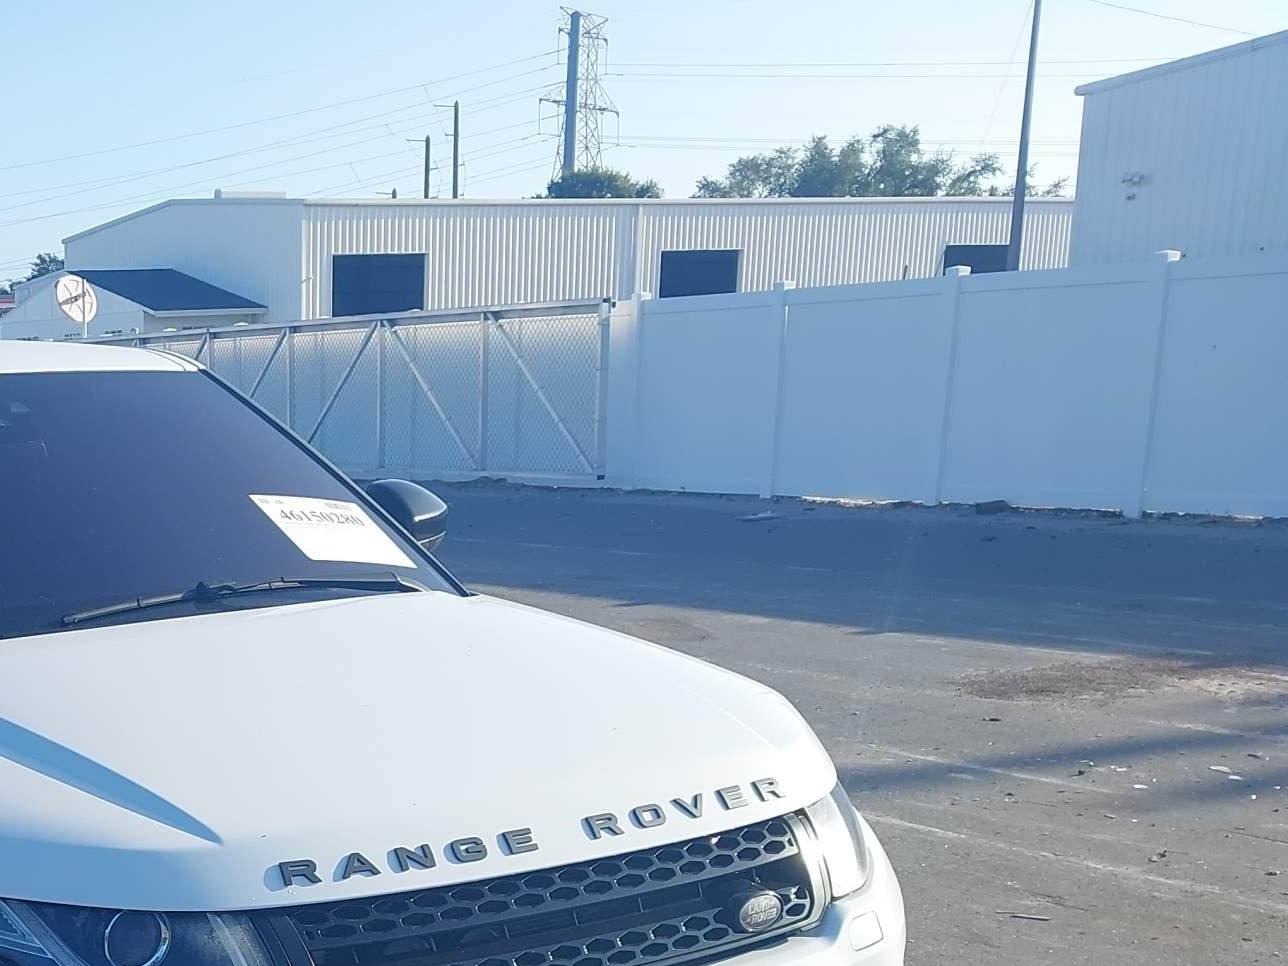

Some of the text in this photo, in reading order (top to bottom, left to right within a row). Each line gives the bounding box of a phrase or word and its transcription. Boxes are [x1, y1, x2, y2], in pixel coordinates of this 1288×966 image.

[279, 508, 367, 528] 46150280
[278, 776, 787, 887] RANGE ROVER
[748, 900, 772, 916] LAND
[750, 908, 778, 925] ROVER
